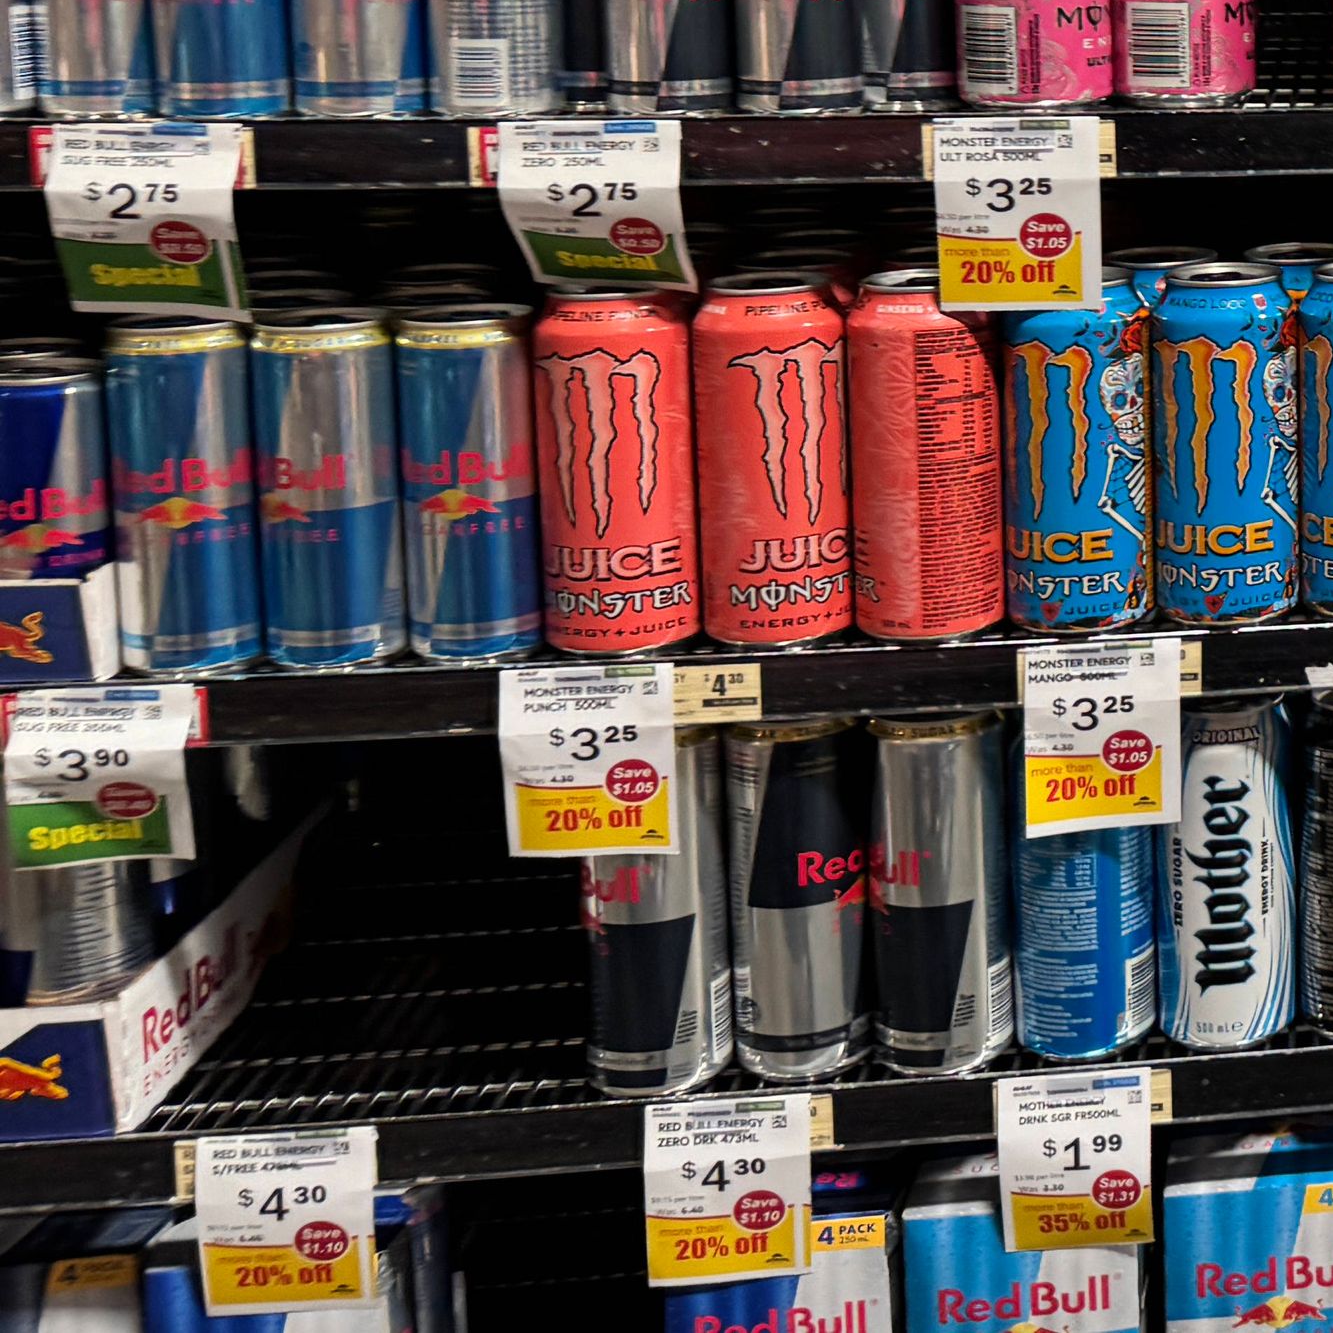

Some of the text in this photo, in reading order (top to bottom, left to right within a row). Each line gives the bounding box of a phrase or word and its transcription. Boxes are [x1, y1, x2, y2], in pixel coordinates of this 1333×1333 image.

[940, 137, 998, 148] MONSTER
[1026, 222, 1065, 234] Save
[1025, 236, 1068, 249] $1.05
[961, 260, 1056, 284] 20% off
[1028, 656, 1132, 670] MONSTER ENERGY
[523, 685, 584, 698] MONSTER
[1109, 737, 1146, 750] Save
[1046, 774, 1137, 803] 20% off
[545, 806, 644, 832] 20% off
[28, 818, 144, 850] Special
[1038, 1210, 1127, 1235] 35% off
[235, 1263, 334, 1287] 20% off
[1195, 1256, 1279, 1298] Red
[937, 1274, 1111, 1325] Red Bull
